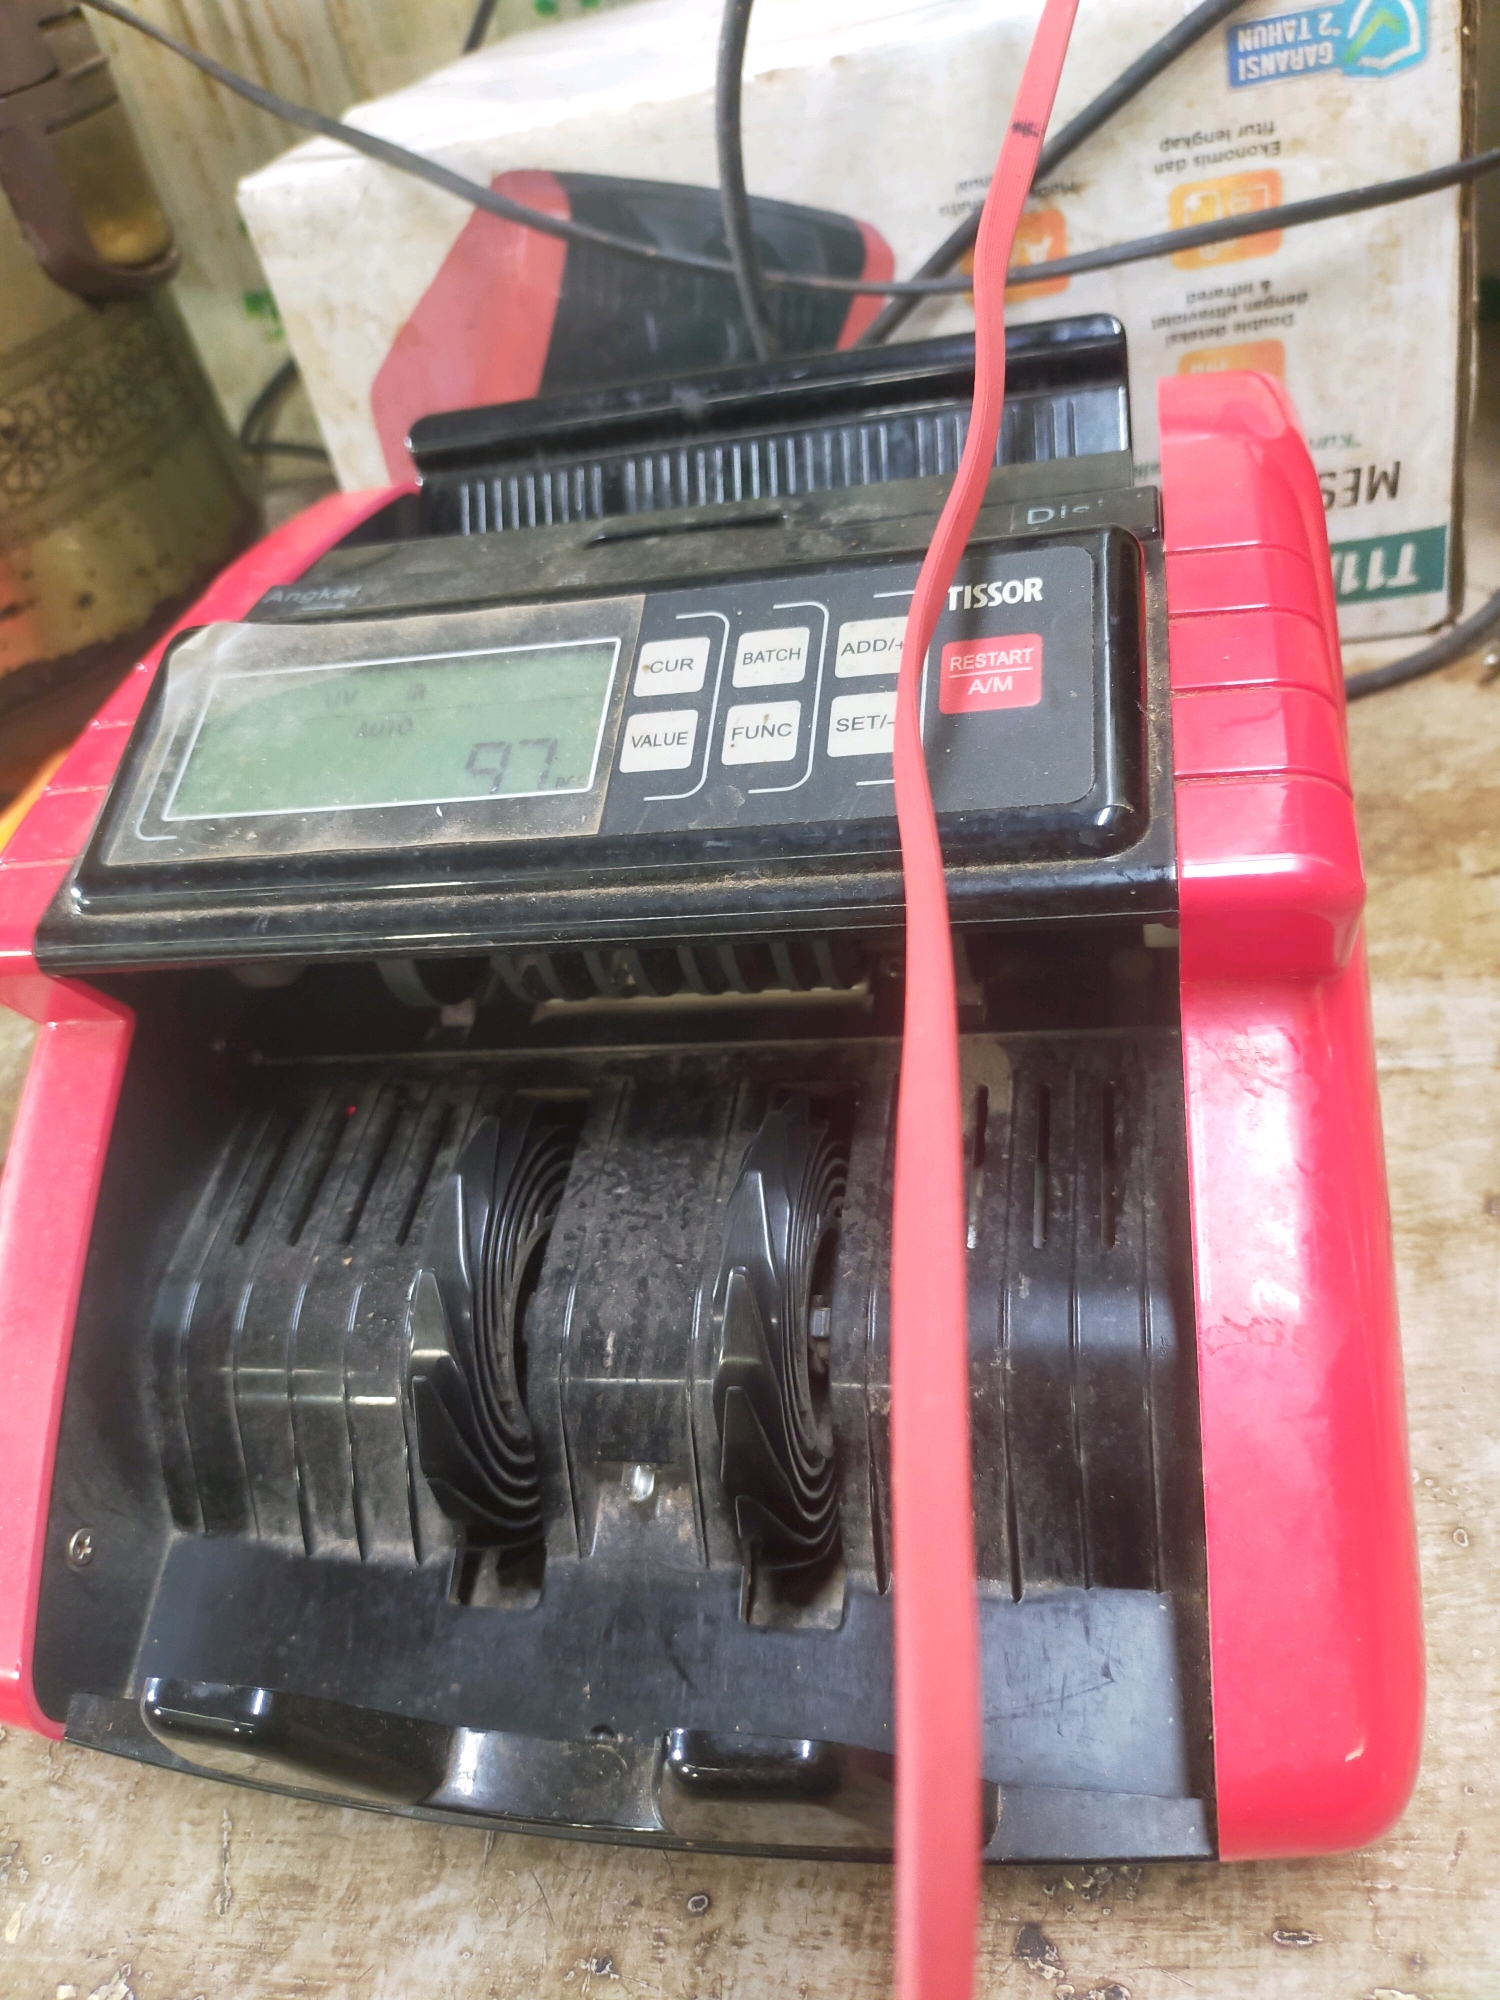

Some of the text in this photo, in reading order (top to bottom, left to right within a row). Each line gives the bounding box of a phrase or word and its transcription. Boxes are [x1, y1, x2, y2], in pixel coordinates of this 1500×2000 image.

[1237, 17, 1312, 52] TAHUN
[1238, 41, 1334, 81] GARANSI
[1160, 121, 1274, 152] fitur lengkap
[1154, 141, 1282, 175] Ekonomis dan
[1319, 460, 1401, 512] MES
[1332, 542, 1419, 596] T11
[947, 577, 1044, 611] TISSOR
[650, 658, 694, 674] CUR
[742, 647, 801, 665] BATCH
[949, 646, 1034, 672] RESTART
[967, 675, 1014, 696] A/M
[355, 716, 415, 739] AUTO
[631, 731, 688, 749] VALUE
[731, 722, 793, 741] FUNC
[465, 737, 560, 795] 97
